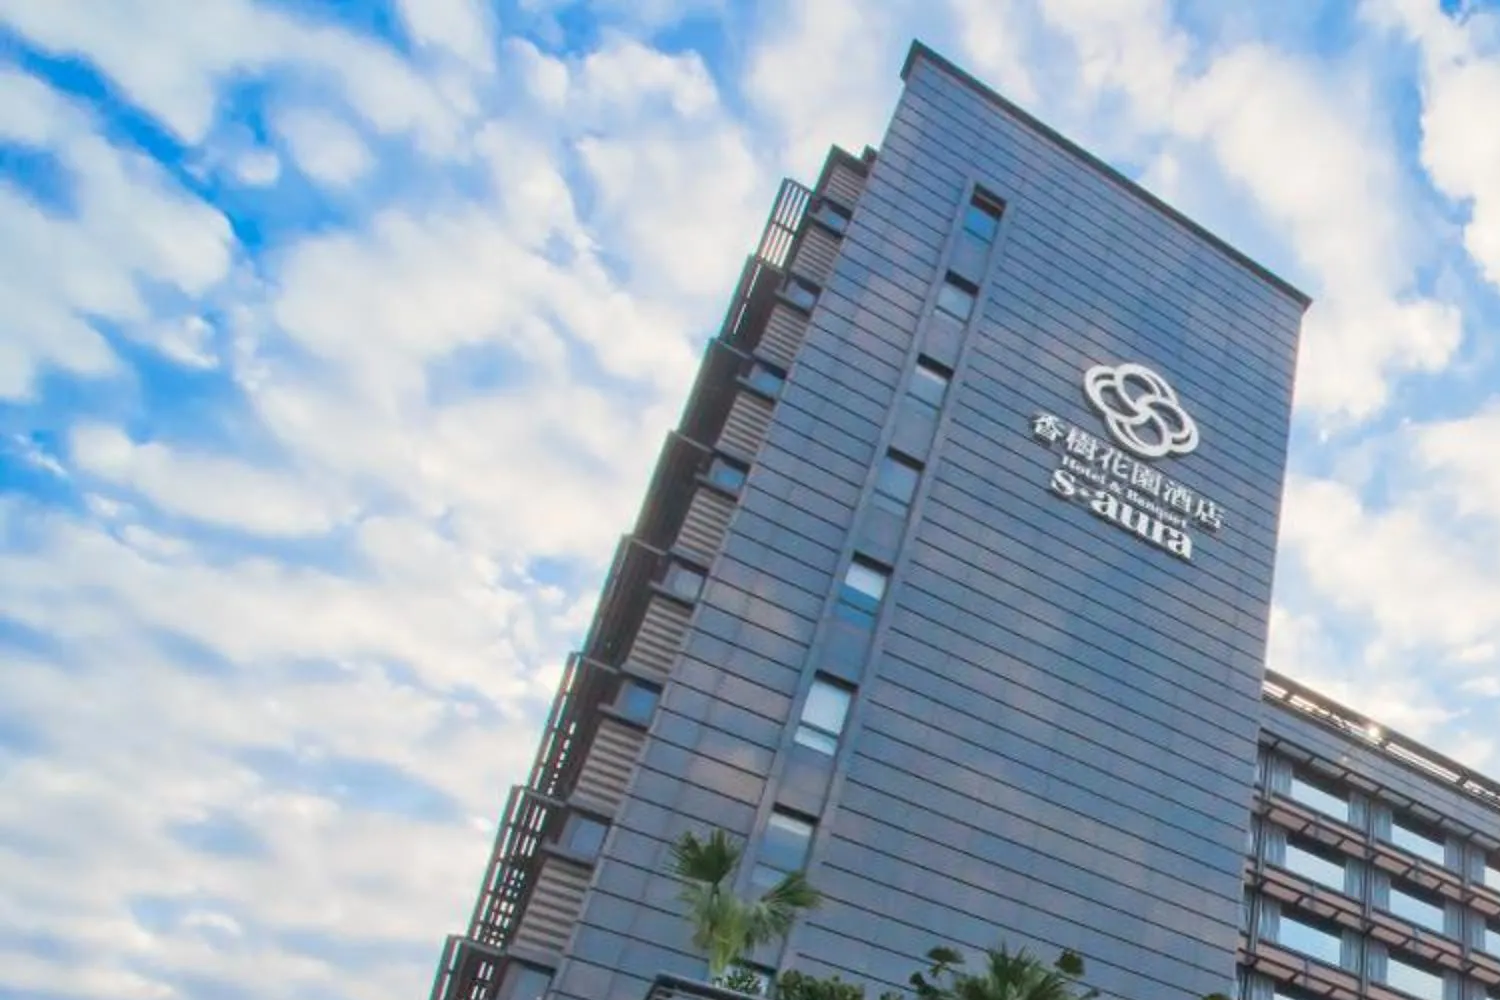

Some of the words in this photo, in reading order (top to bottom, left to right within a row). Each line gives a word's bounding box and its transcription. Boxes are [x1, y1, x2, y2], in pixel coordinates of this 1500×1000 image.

[1033, 412, 1225, 529] 香樹花園酒店
[1062, 455, 1106, 485] Hotel
